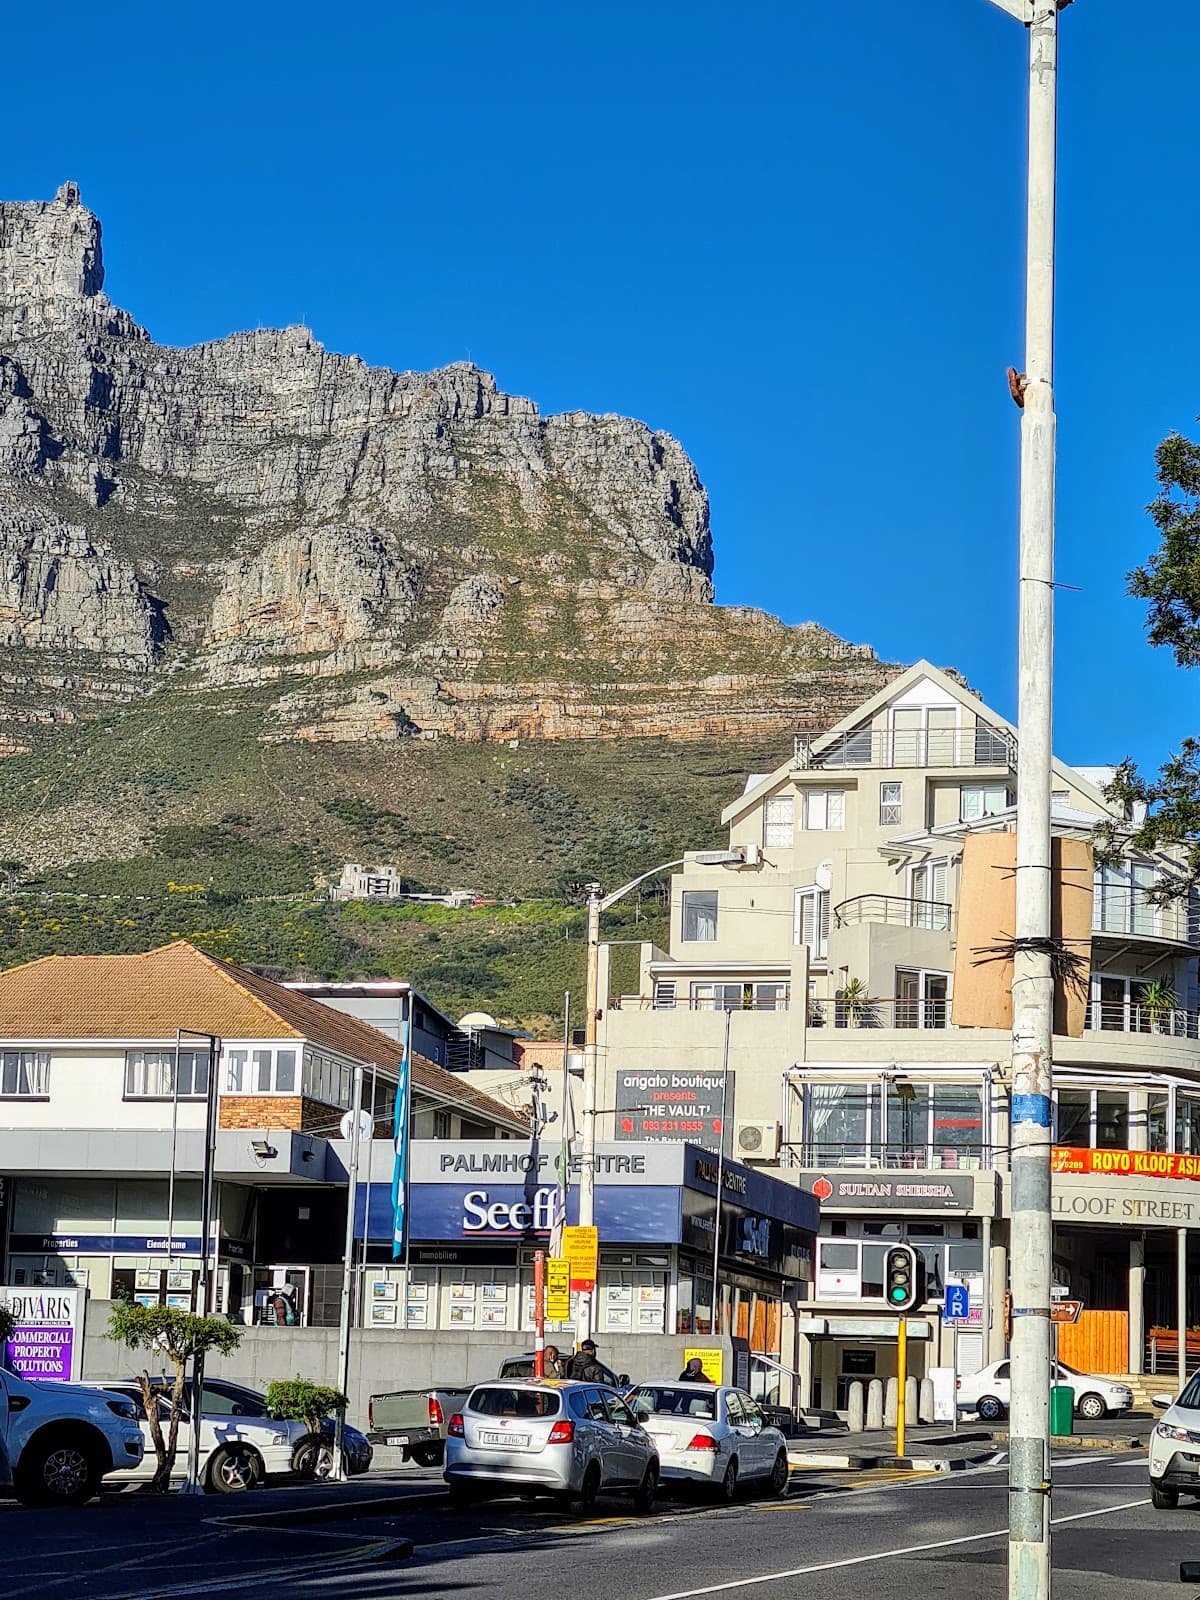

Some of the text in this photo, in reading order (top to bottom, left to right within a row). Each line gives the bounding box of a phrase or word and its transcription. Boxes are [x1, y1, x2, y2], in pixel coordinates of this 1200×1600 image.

[623, 1074, 727, 1090] arigato boutique
[652, 1091, 697, 1101] presents
[681, 1121, 703, 1132] 9555
[440, 1154, 548, 1172] PALMHOF
[1092, 1152, 1130, 1170] ROYO
[1134, 1154, 1175, 1173] KLOOF
[839, 1183, 892, 1196] SULTAN
[463, 1188, 556, 1230] Seeff
[1052, 1196, 1195, 1220] LOOF STREET
[43, 1239, 78, 1248] Properties
[419, 1250, 457, 1260] Immobilien
[12, 1293, 71, 1319] DIVARIS
[952, 1301, 963, 1316] R
[8, 1331, 71, 1344] COMMERCIAL
[14, 1345, 62, 1358] PROPERTY
[12, 1360, 63, 1373] SOLUTIONS
